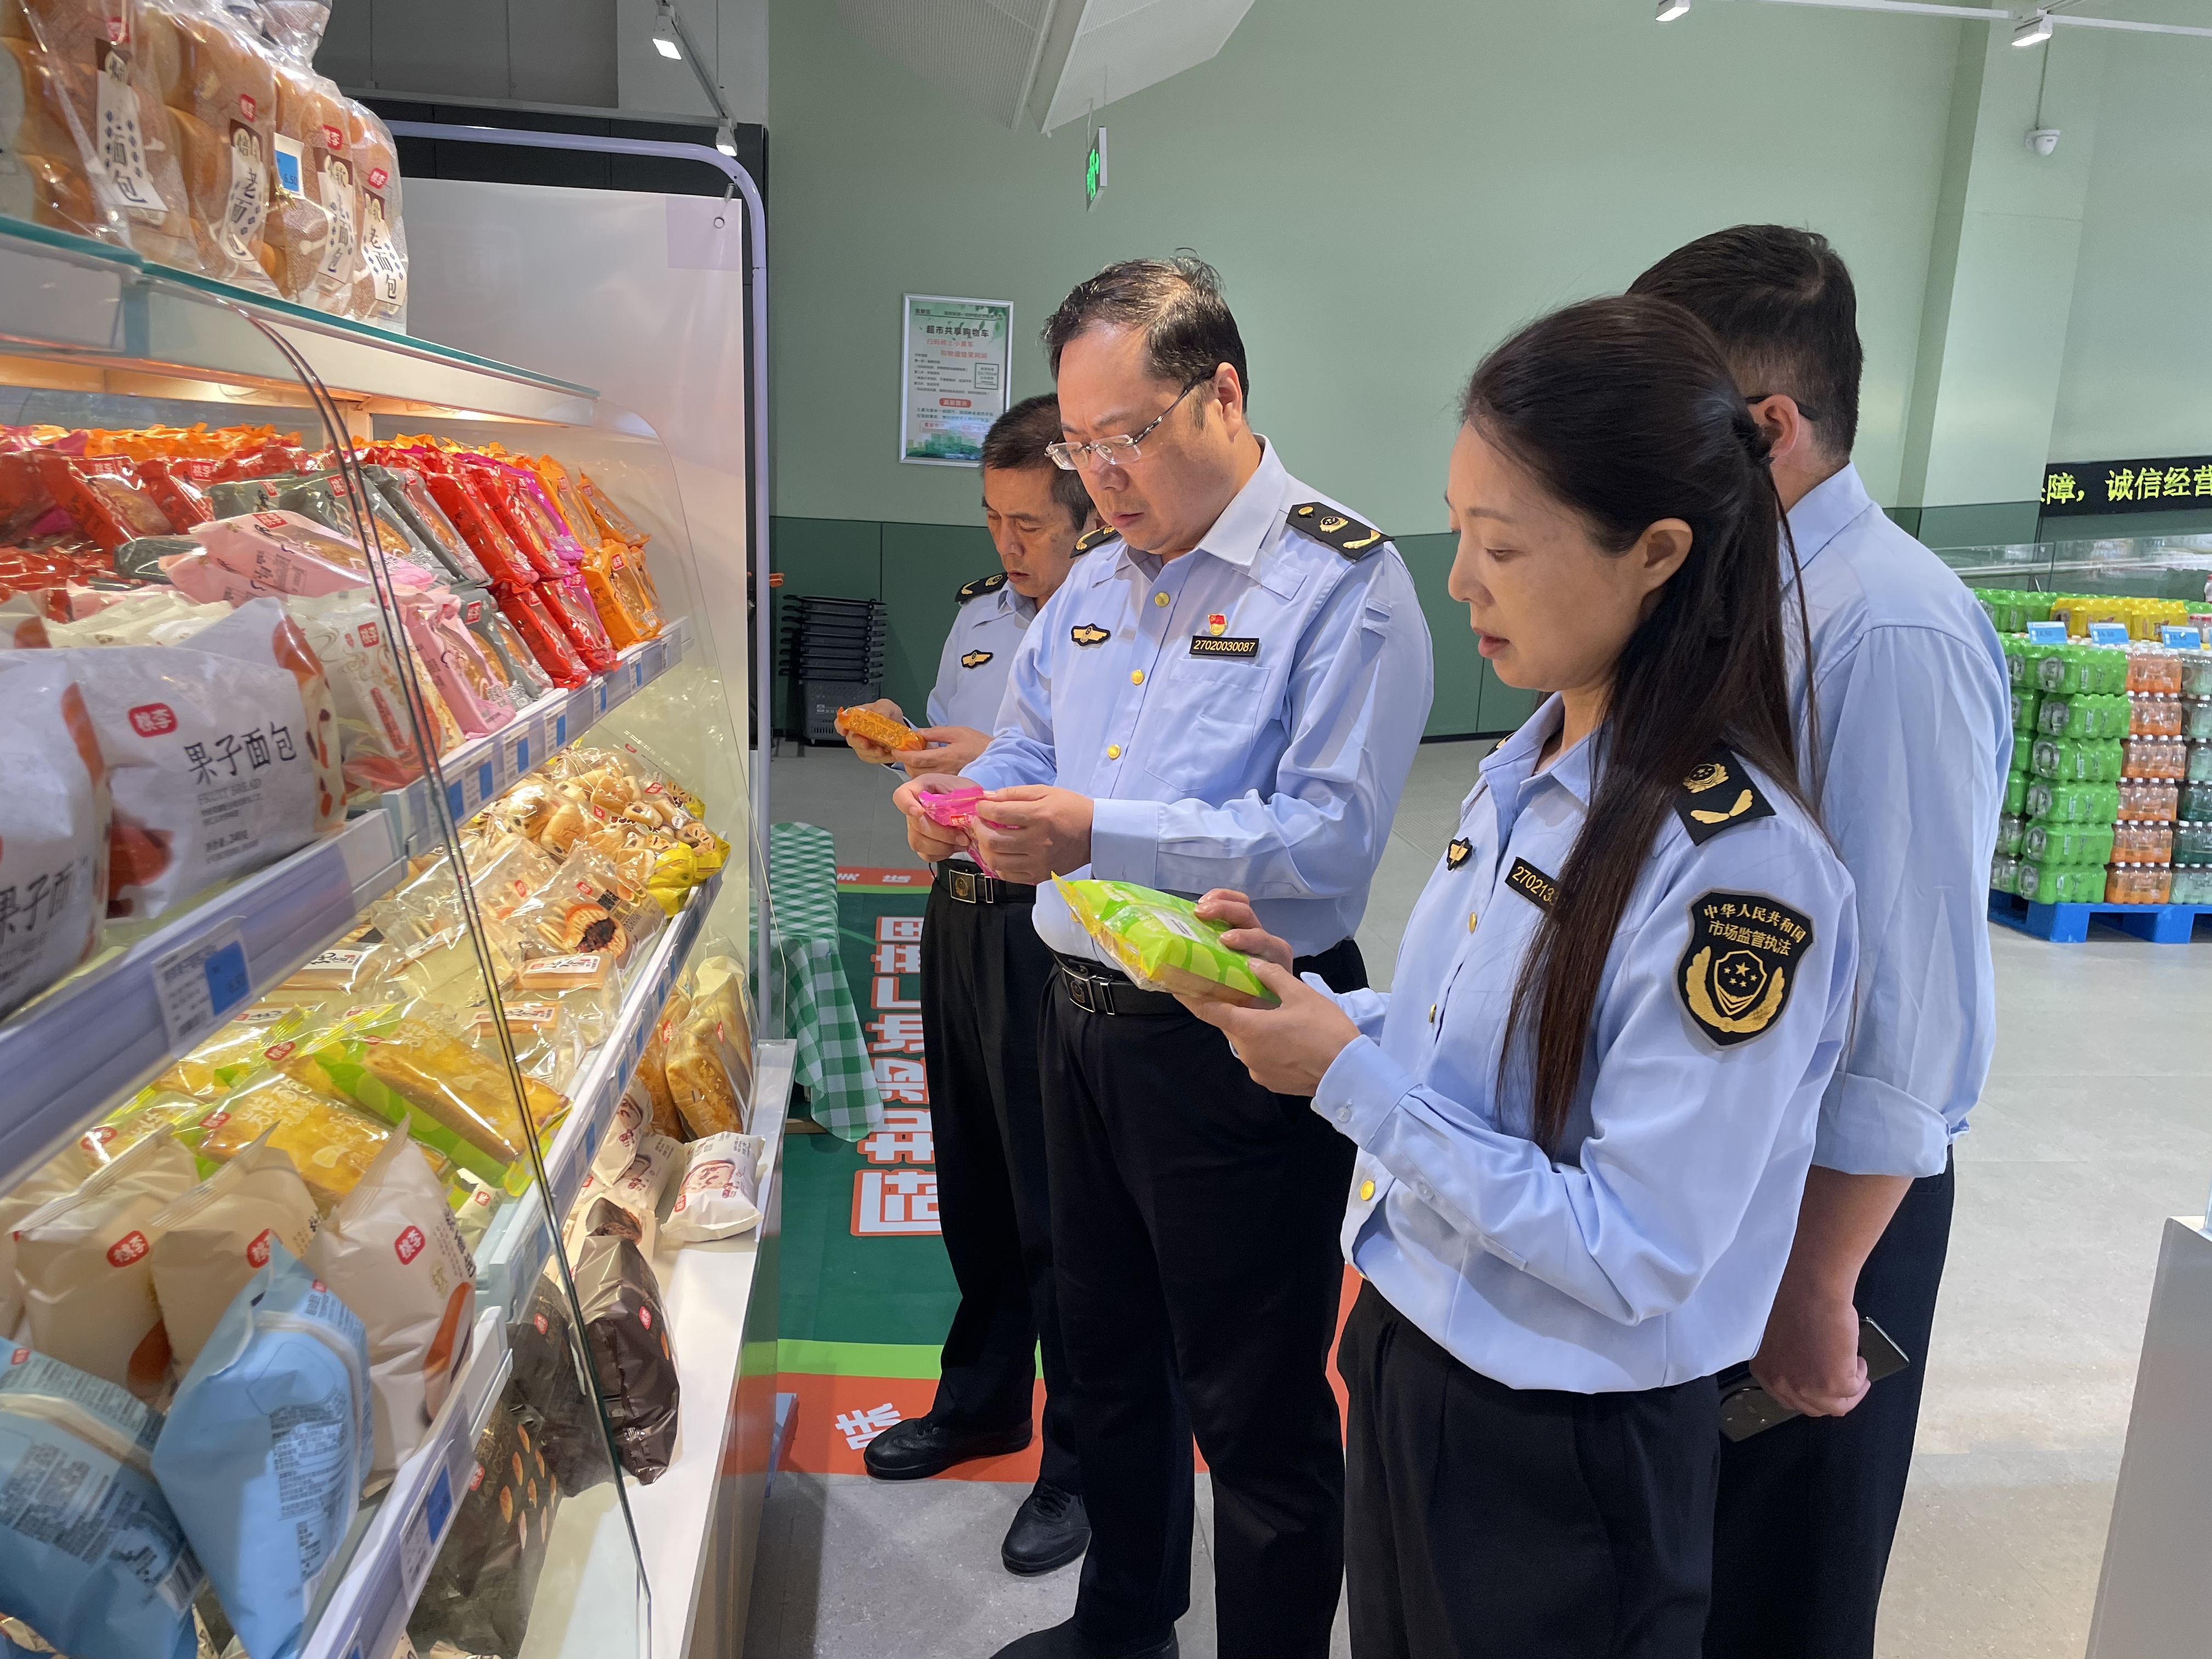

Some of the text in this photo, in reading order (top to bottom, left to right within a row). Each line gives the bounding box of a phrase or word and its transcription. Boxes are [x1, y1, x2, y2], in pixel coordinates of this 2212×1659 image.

[284, 172, 298, 187] 6.50
[369, 225, 397, 300] 老面包
[926, 325, 989, 338] 超市共享购物车
[2040, 465, 2212, 505] 障，诚信经营
[1193, 639, 1256, 653] 27020030087
[134, 708, 172, 732] 桃李
[183, 720, 297, 786] 果子面包
[1703, 903, 1807, 944] 中华人民共和国
[1708, 919, 1792, 956] 市场监管执法
[114, 1234, 145, 1263] 桃李
[398, 1229, 422, 1260] 桃李
